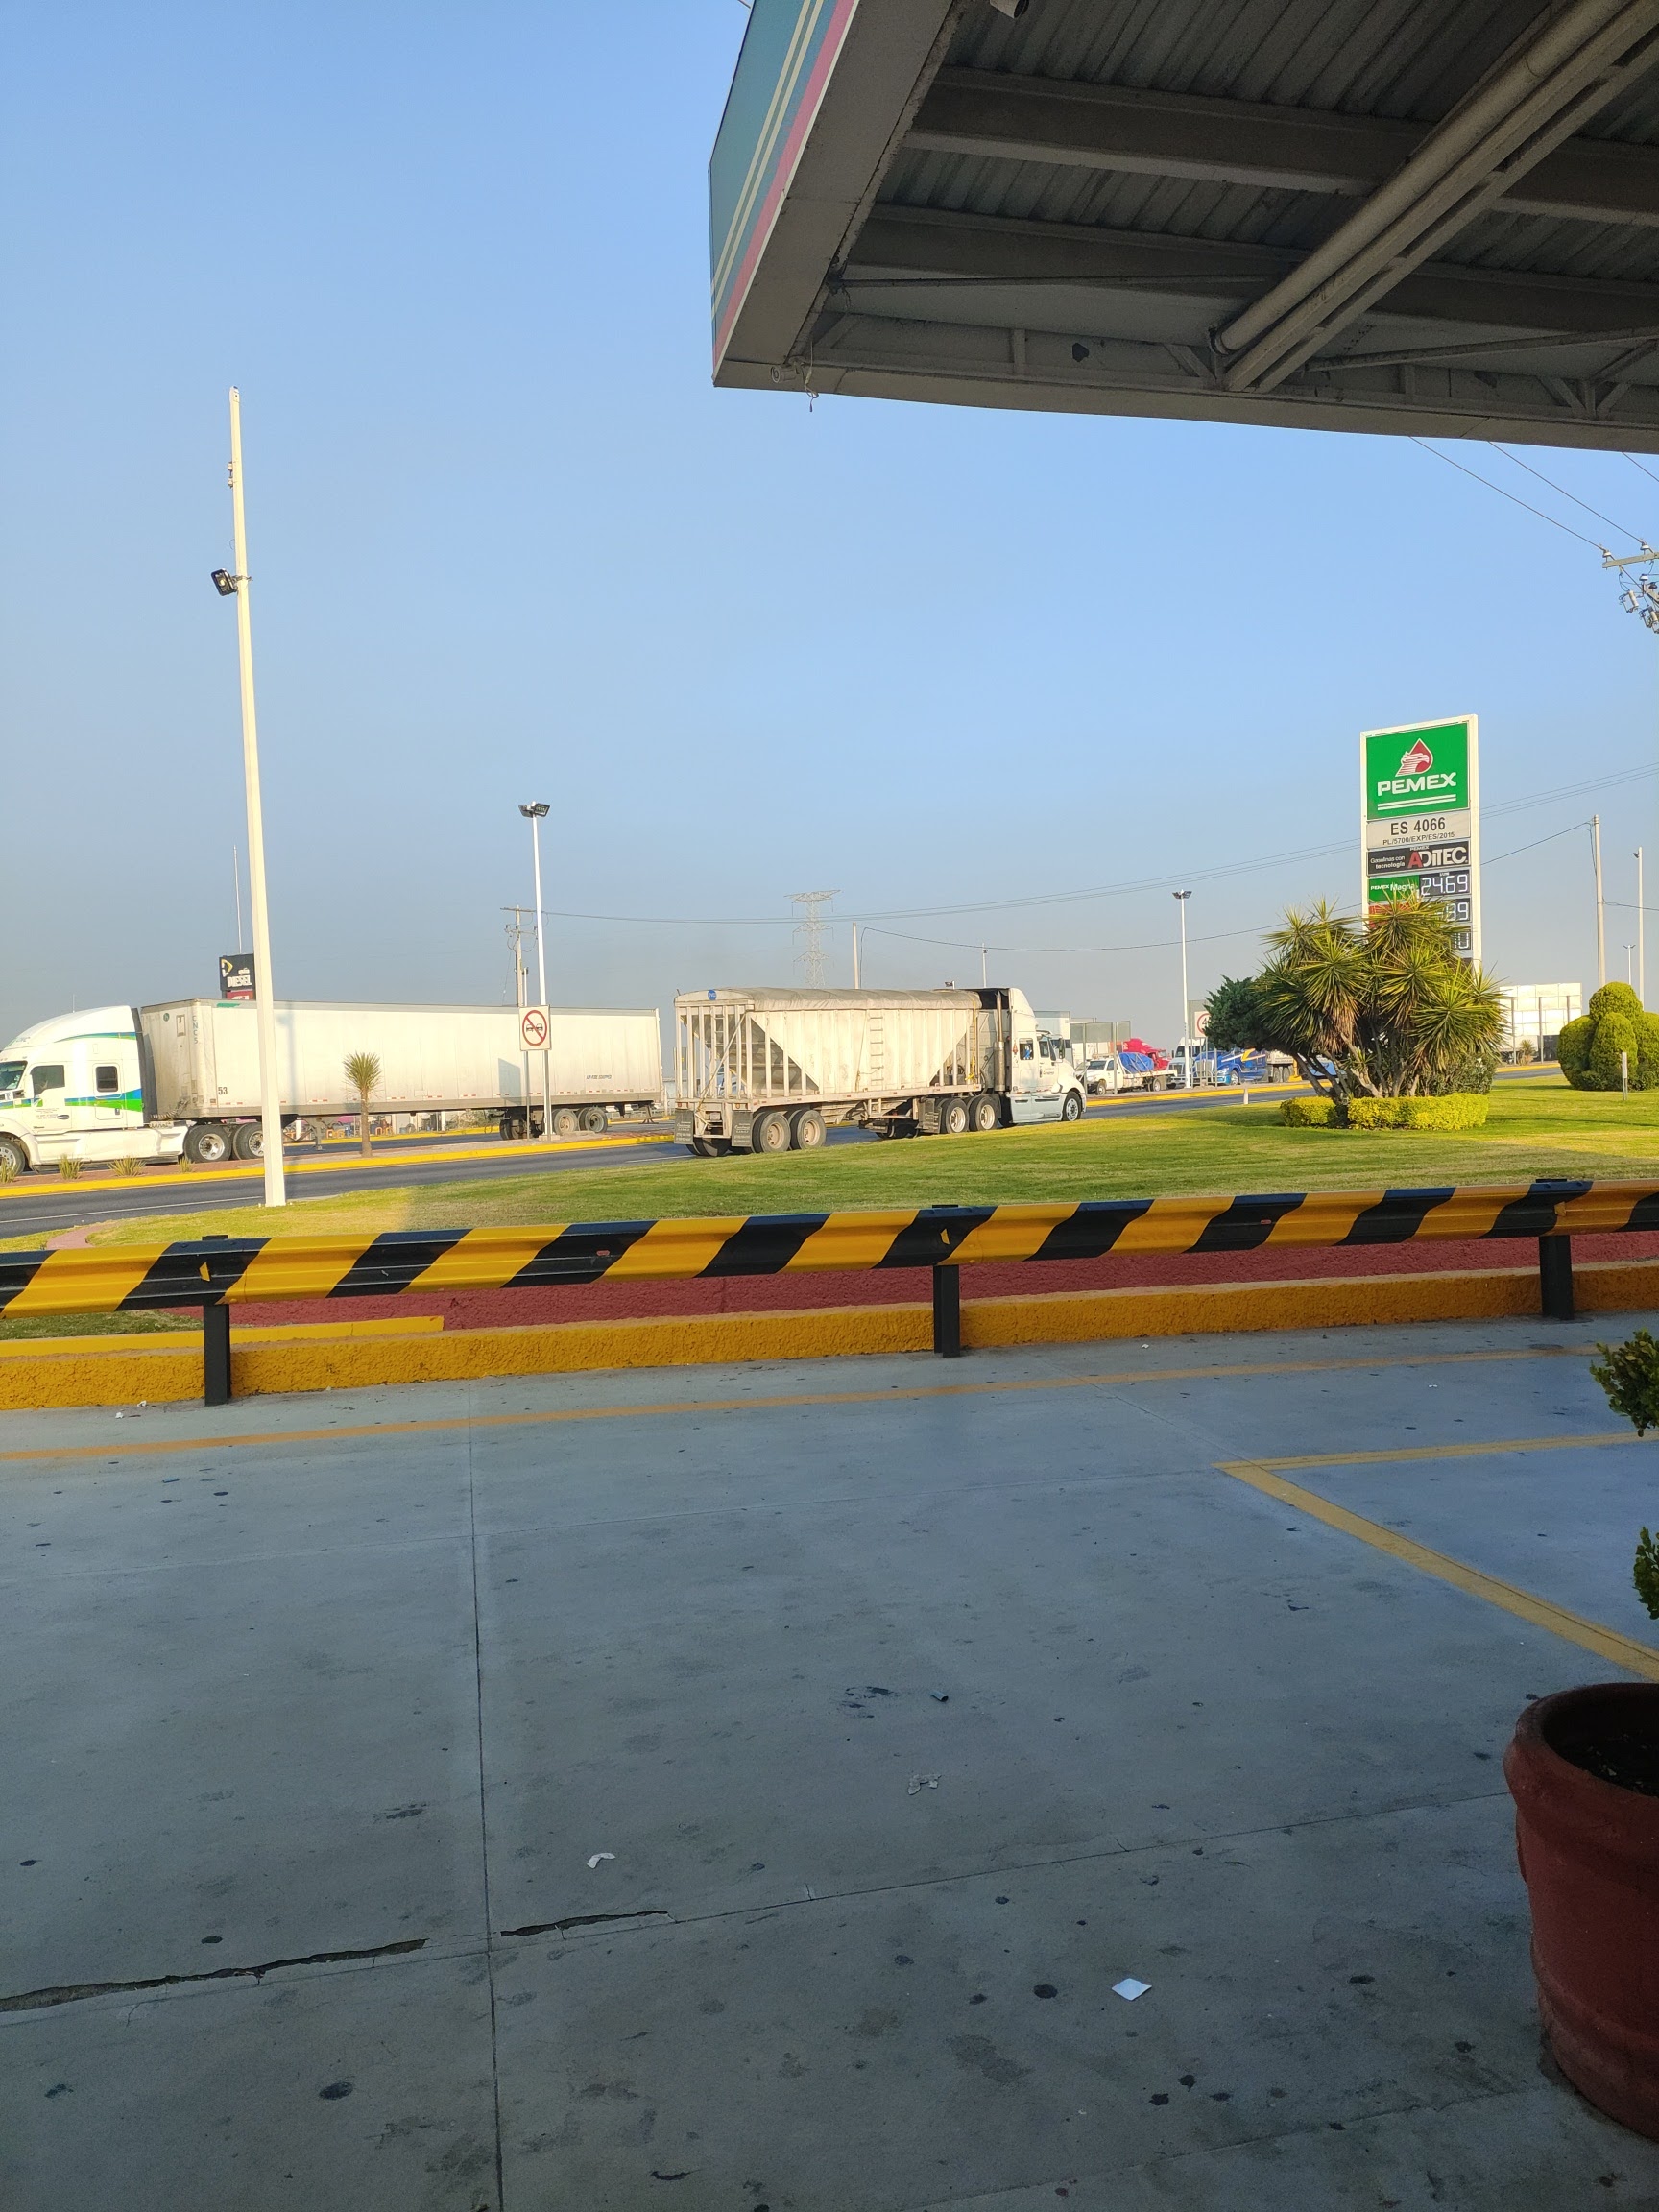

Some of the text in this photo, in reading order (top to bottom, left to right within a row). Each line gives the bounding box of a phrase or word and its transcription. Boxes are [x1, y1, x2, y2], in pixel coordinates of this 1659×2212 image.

[1377, 772, 1456, 797] PEMEX
[1390, 817, 1446, 836] ES 4066
[1382, 831, 1455, 846] PL/5700/EXP/ES/2015
[218, 1087, 228, 1095] 53
